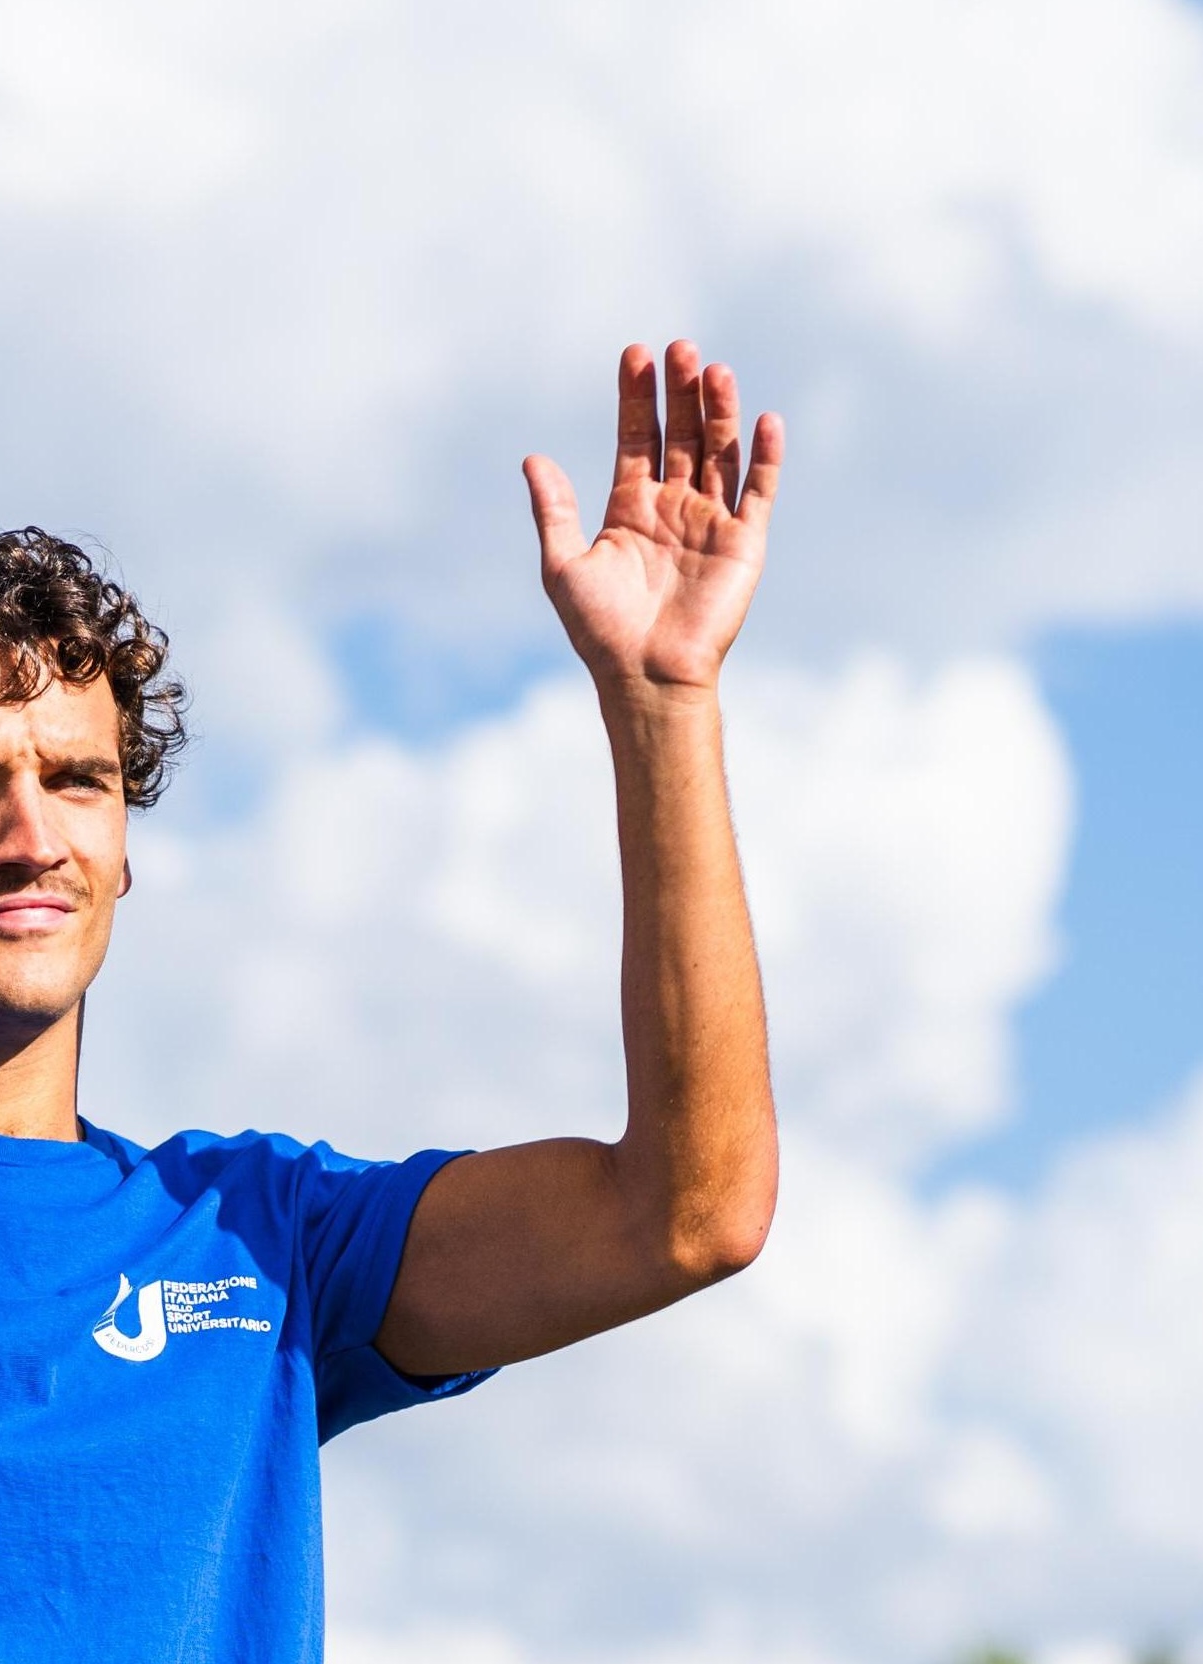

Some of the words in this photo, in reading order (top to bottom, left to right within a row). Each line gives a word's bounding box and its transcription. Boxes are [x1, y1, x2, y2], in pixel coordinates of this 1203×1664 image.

[163, 1276, 258, 1294] FEDERAZIONE
[164, 1290, 229, 1305] ITALIANA
[165, 1304, 193, 1312] DELLO
[166, 1310, 211, 1323] SPORT
[168, 1318, 272, 1334] UNIVERSITARIO
